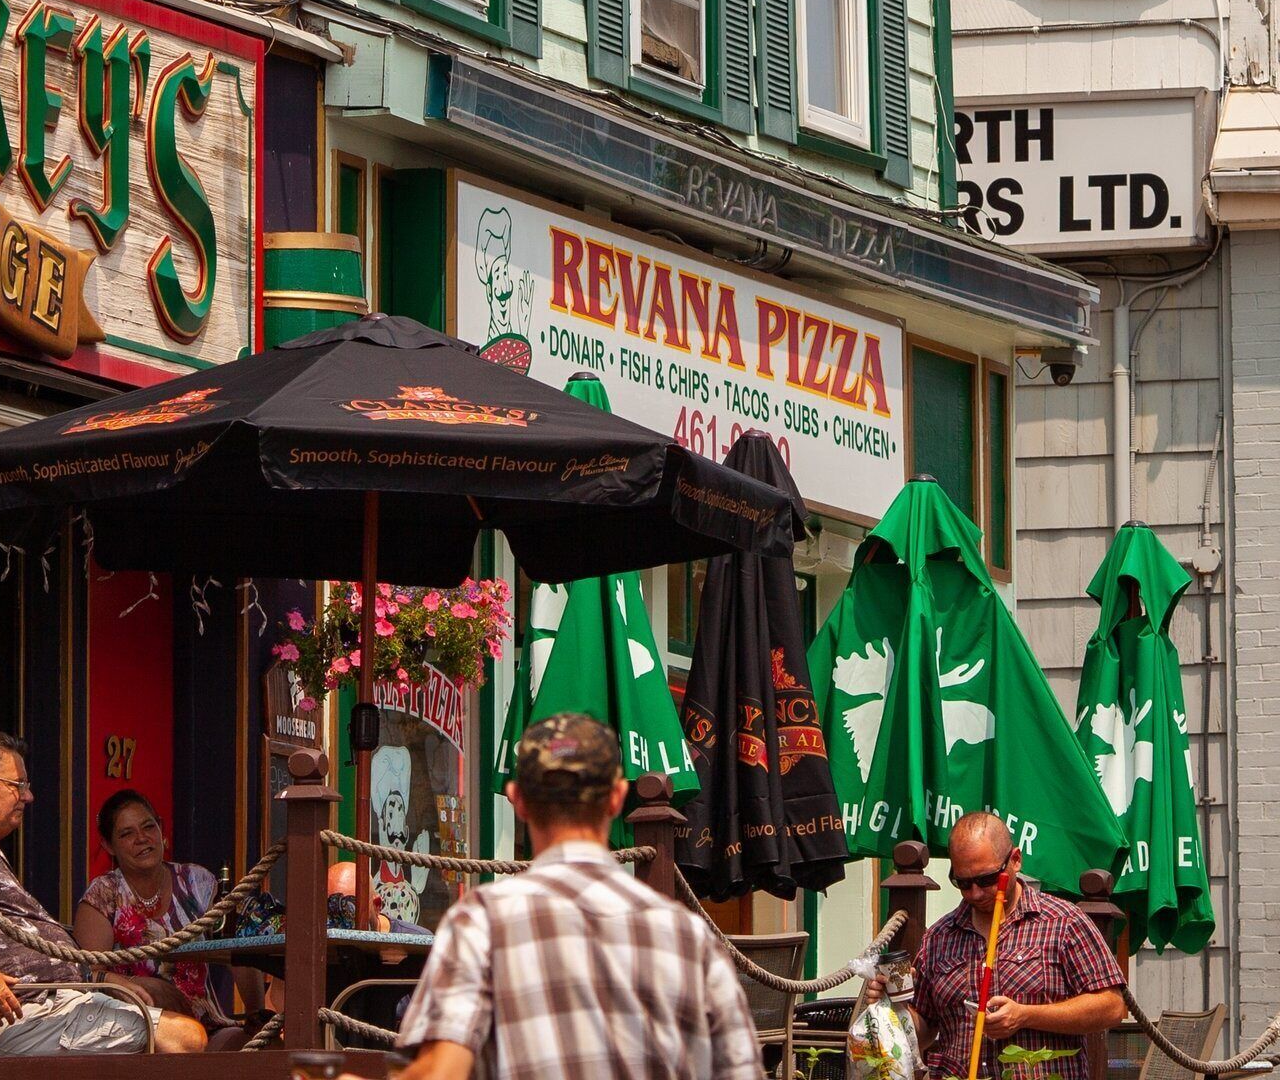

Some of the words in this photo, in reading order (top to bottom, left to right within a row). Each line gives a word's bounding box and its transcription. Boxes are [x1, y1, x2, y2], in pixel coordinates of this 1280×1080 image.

[687, 165, 778, 233] REVANA
[828, 214, 896, 270] PIZZA
[1059, 172, 1182, 232] LTD.
[548, 225, 746, 372] REVANA
[755, 295, 892, 420] PIZZA
[350, 399, 526, 420] CLANCY'S
[549, 325, 605, 372] DONAIR
[620, 348, 653, 388] FISH
[655, 358, 666, 391] &
[669, 365, 710, 404] CHIPS
[724, 380, 770, 423] TACOS
[783, 399, 819, 438] SUBS
[832, 415, 890, 461] CHICKEN
[386, 411, 456, 420] AMBER
[34, 455, 121, 481] Sophisticated
[122, 452, 169, 470] Flavour
[289, 448, 363, 466] Smooth,
[368, 450, 487, 470] Sophisticated
[492, 456, 557, 473] Flavour
[276, 715, 316, 741] MOOSEHEAD
[108, 735, 137, 780] 27
